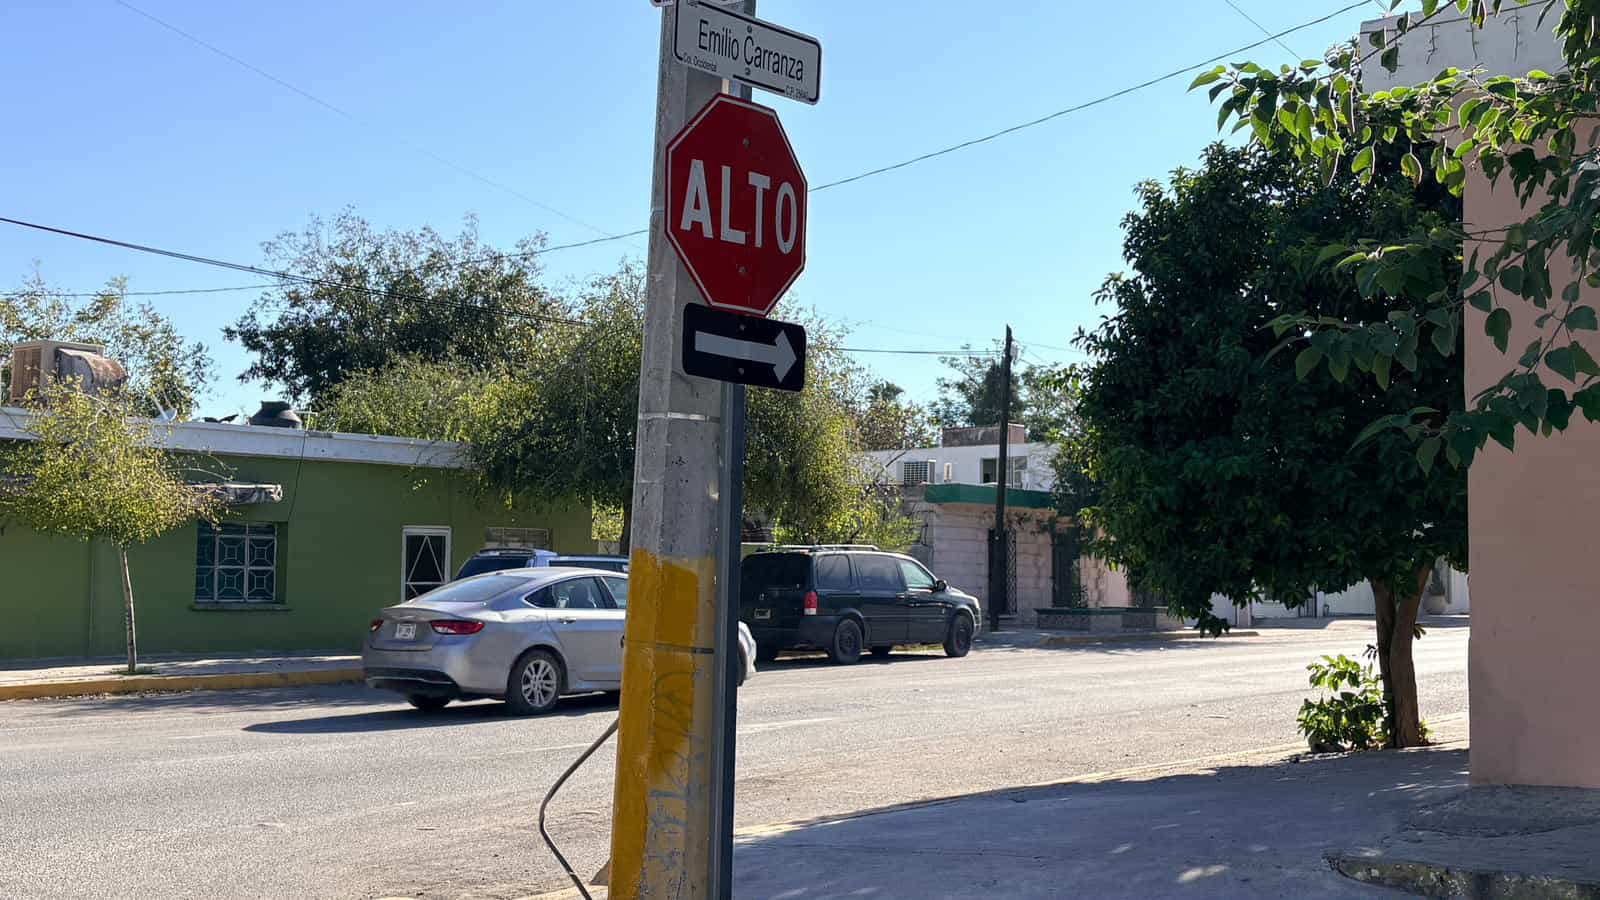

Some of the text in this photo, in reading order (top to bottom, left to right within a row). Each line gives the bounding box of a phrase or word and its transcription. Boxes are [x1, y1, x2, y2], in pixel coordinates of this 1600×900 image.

[698, 19, 804, 82] Emilio Carranza
[680, 158, 798, 254] ALTO
